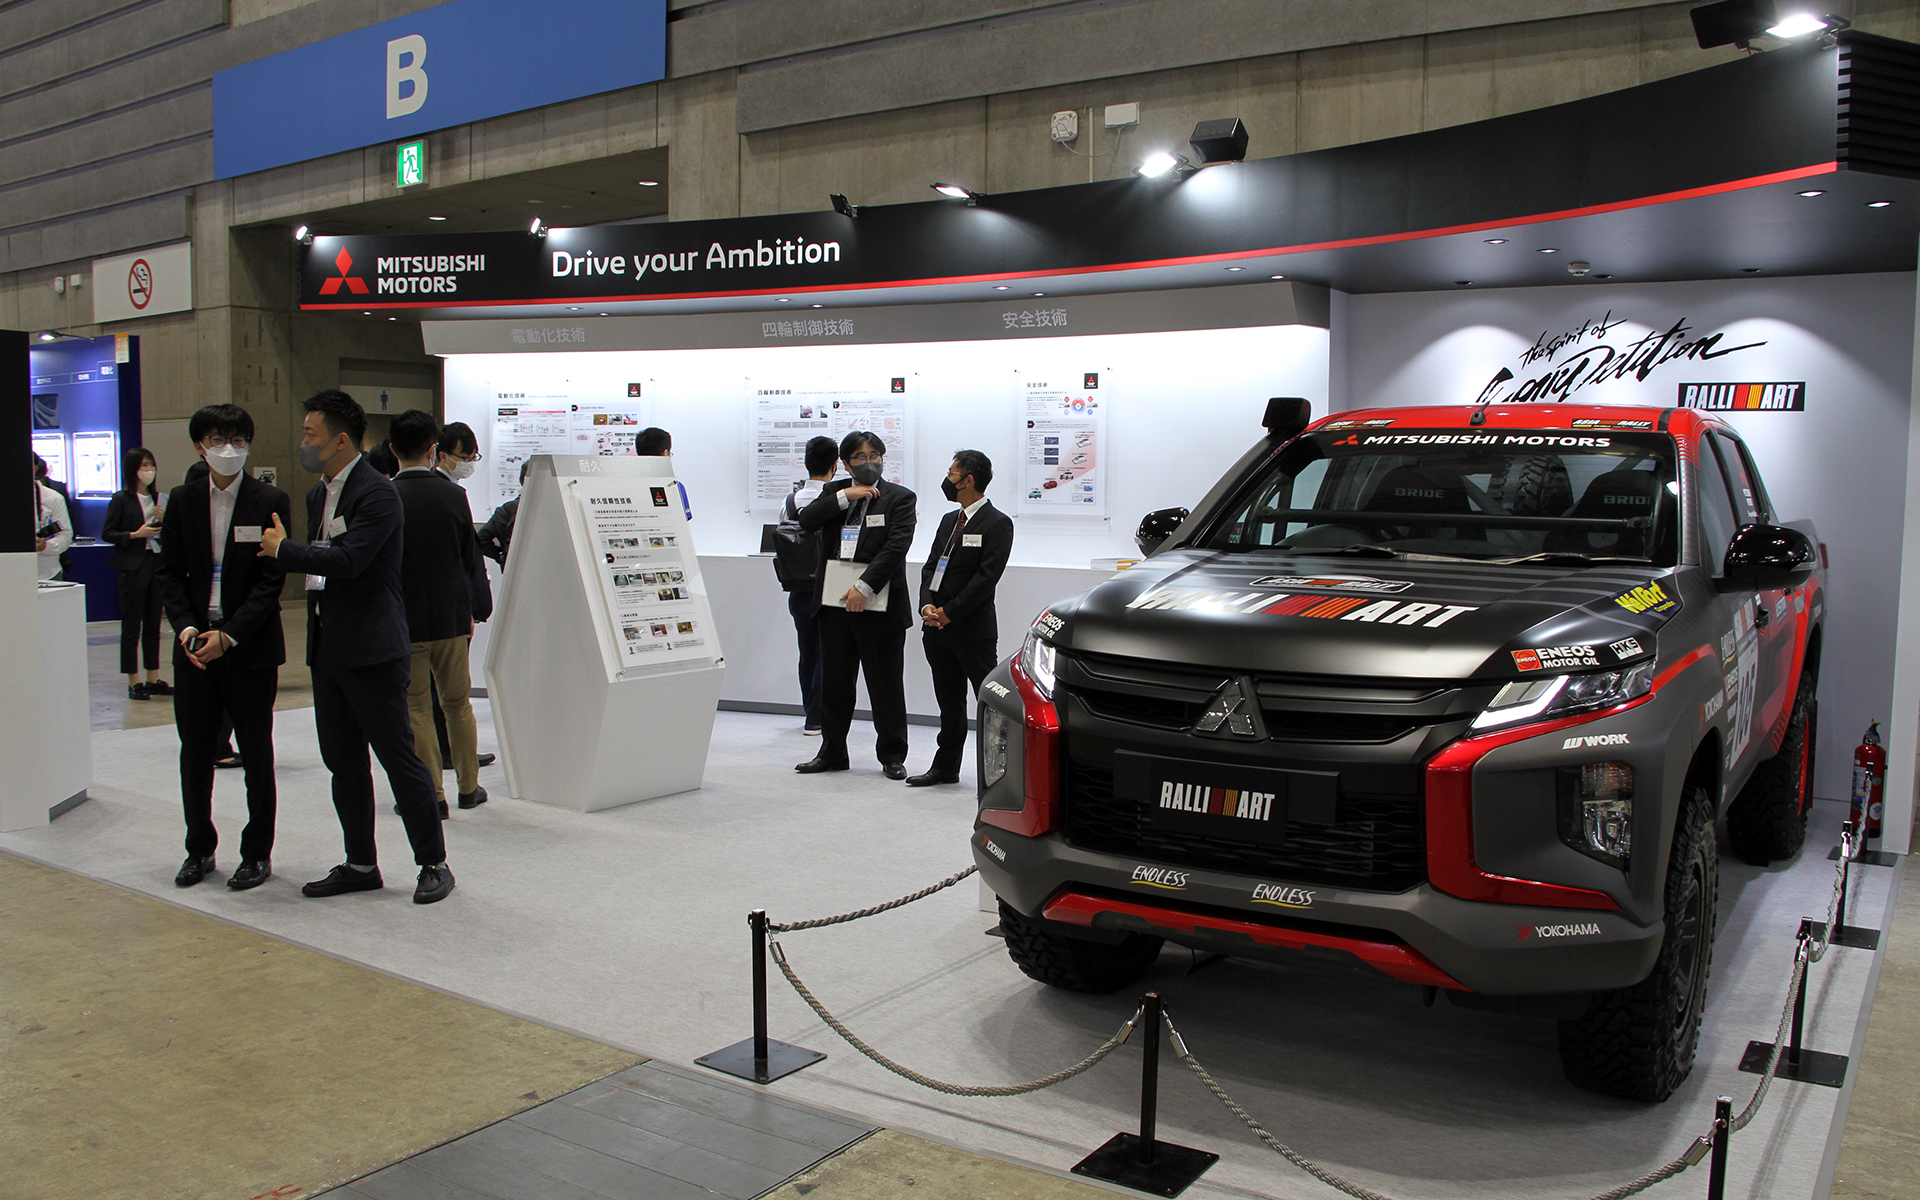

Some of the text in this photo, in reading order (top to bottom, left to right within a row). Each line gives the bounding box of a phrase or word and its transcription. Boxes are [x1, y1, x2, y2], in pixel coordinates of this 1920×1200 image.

[386, 34, 428, 119] B
[377, 254, 485, 274] MITSUBISHI
[552, 236, 840, 281] Drive your Ambition
[377, 276, 457, 294] MOTORS
[1002, 308, 1068, 329] 安全技術
[511, 327, 586, 344] 電動化技術
[761, 319, 854, 338] 四輪制御技術
[1684, 383, 1799, 409] RALLI ART
[1362, 435, 1611, 448] MITSUBISHI MOTORS
[1394, 487, 1445, 499] BRIDE
[1603, 495, 1650, 505] BRID
[1125, 590, 1480, 628] RALLI ART
[1041, 613, 1066, 631] ENEOS
[1536, 645, 1596, 660] ENEOS
[1611, 638, 1640, 654] HKS
[1516, 656, 1537, 664] ENEOS
[1542, 656, 1600, 669] MOTOR OIL
[1584, 733, 1630, 748] WORK
[1159, 781, 1275, 821] RALLI ART
[1131, 865, 1190, 887] ENDLESS
[1252, 883, 1316, 906] ENDLESS
[1535, 923, 1601, 938] YOKOHAMA
